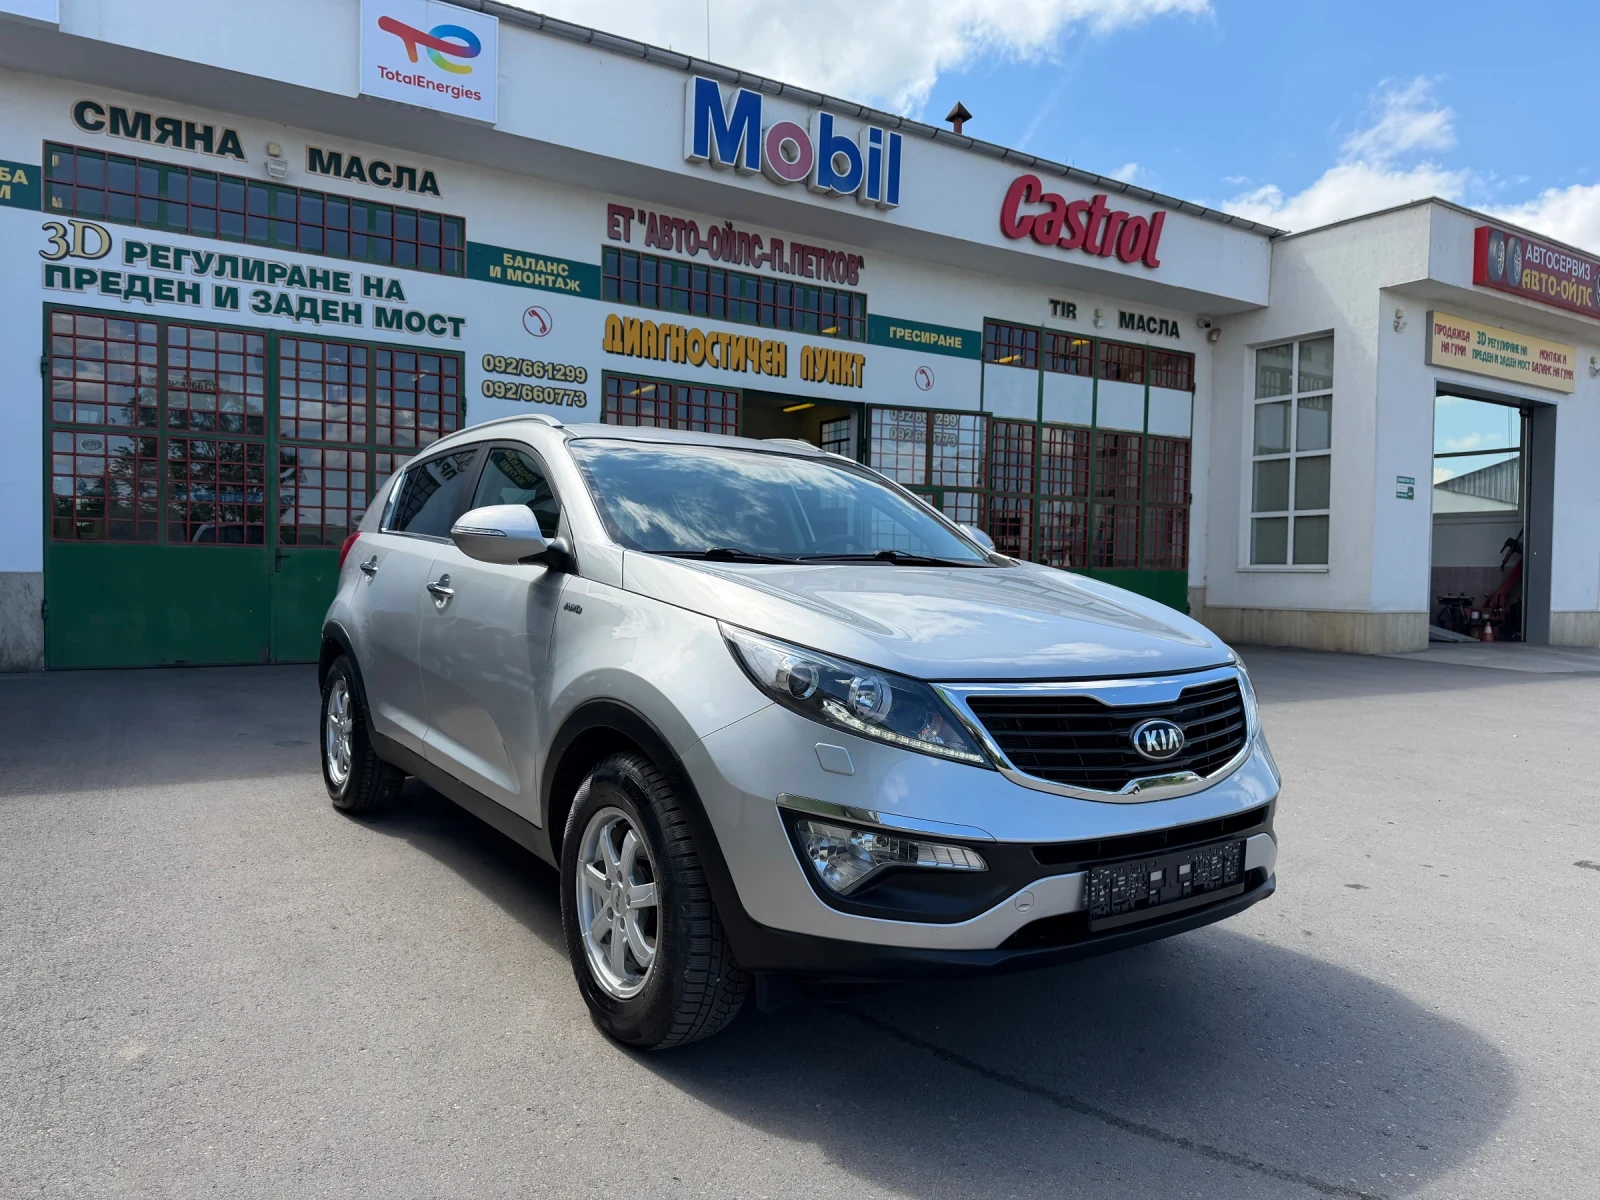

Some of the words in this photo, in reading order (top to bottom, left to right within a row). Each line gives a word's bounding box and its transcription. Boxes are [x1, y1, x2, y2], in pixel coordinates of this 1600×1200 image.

[377, 65, 482, 101] TotalEnergies
[71, 99, 248, 162] СМЯНА
[306, 145, 443, 198] МАСЛА
[686, 75, 903, 210] Mobil
[607, 203, 634, 243] ЕТ
[1000, 174, 1166, 268] Castrol
[39, 220, 112, 261] 3D
[122, 238, 353, 296] РЕГУЛИРАНЕ
[361, 273, 407, 303] НА
[503, 253, 569, 276] БАЛАНС
[1525, 244, 1591, 280] АВТОСЕРВИЗ
[489, 265, 502, 279] И
[506, 268, 581, 292] МОНТАЖ
[1522, 269, 1592, 307] АВТО-ОЙЛС
[42, 262, 202, 307] ПРЕДЕН
[212, 284, 240, 312] И
[250, 289, 364, 327] ЗАДЕН
[373, 304, 467, 339] МОСТ
[1049, 298, 1077, 320] TIR
[1119, 309, 1181, 339] МАСЛА
[1434, 323, 1471, 342] ПРОДАЖБА
[603, 313, 787, 377] ДИАГНОСТИЧЕН
[800, 345, 865, 388] ПУНКТ
[889, 326, 962, 349] ГРЕСИРАНЕ
[1441, 341, 1449, 354] НА
[1450, 343, 1466, 356] ГУМИ
[1477, 331, 1486, 346] 3D
[1487, 337, 1519, 354] РЕГУЛИРАНЕ
[1520, 345, 1528, 356] НА
[482, 353, 587, 384] 092/661299
[1472, 349, 1493, 364] ПРЕДЕН
[1494, 354, 1499, 364] И
[1517, 359, 1530, 371] МОСТ
[1539, 349, 1562, 364] МОНТАЖ
[1553, 367, 1560, 378] НА
[1560, 368, 1574, 380] ГУМИ
[481, 380, 587, 408] 092/660773
[1143, 728, 1179, 751] KIA
